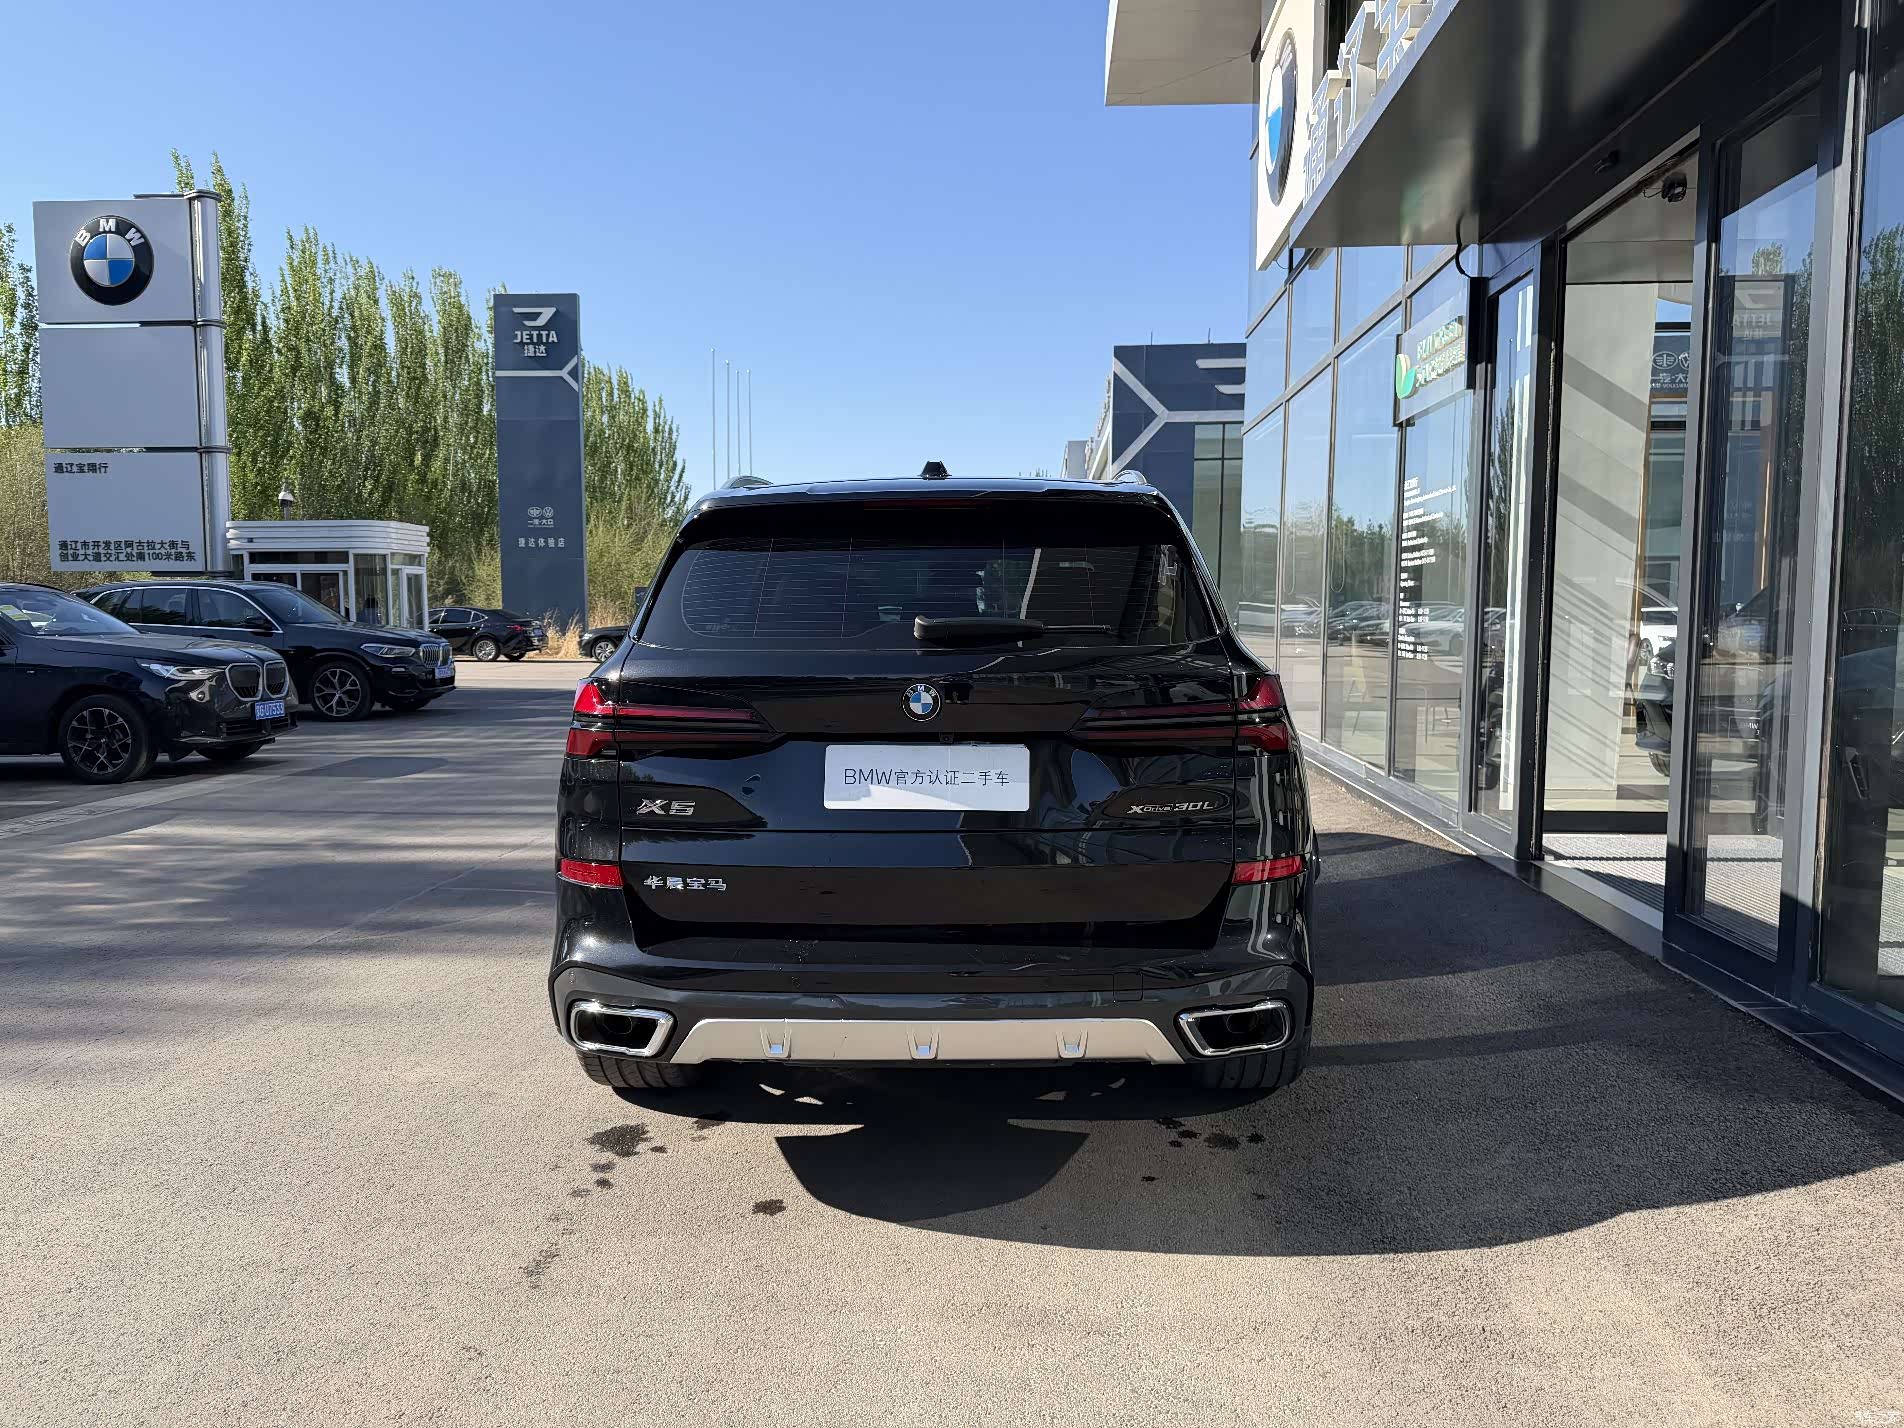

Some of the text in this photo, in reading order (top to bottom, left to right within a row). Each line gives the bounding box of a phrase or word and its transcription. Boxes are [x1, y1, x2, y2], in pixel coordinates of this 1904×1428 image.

[75, 218, 145, 247] BMW
[513, 330, 558, 343] JETTA
[524, 344, 547, 357] 捷达
[53, 462, 109, 474] 通辽宝翔行
[58, 540, 190, 551] 通辽市开发区阿古拉大街与
[59, 551, 197, 562] 创业大道交汇处南100米路东
[906, 685, 937, 697] BMW
[844, 768, 1010, 787] BMW官方认证二手车
[636, 798, 696, 816] X5
[643, 875, 727, 891] 华晨宝马
